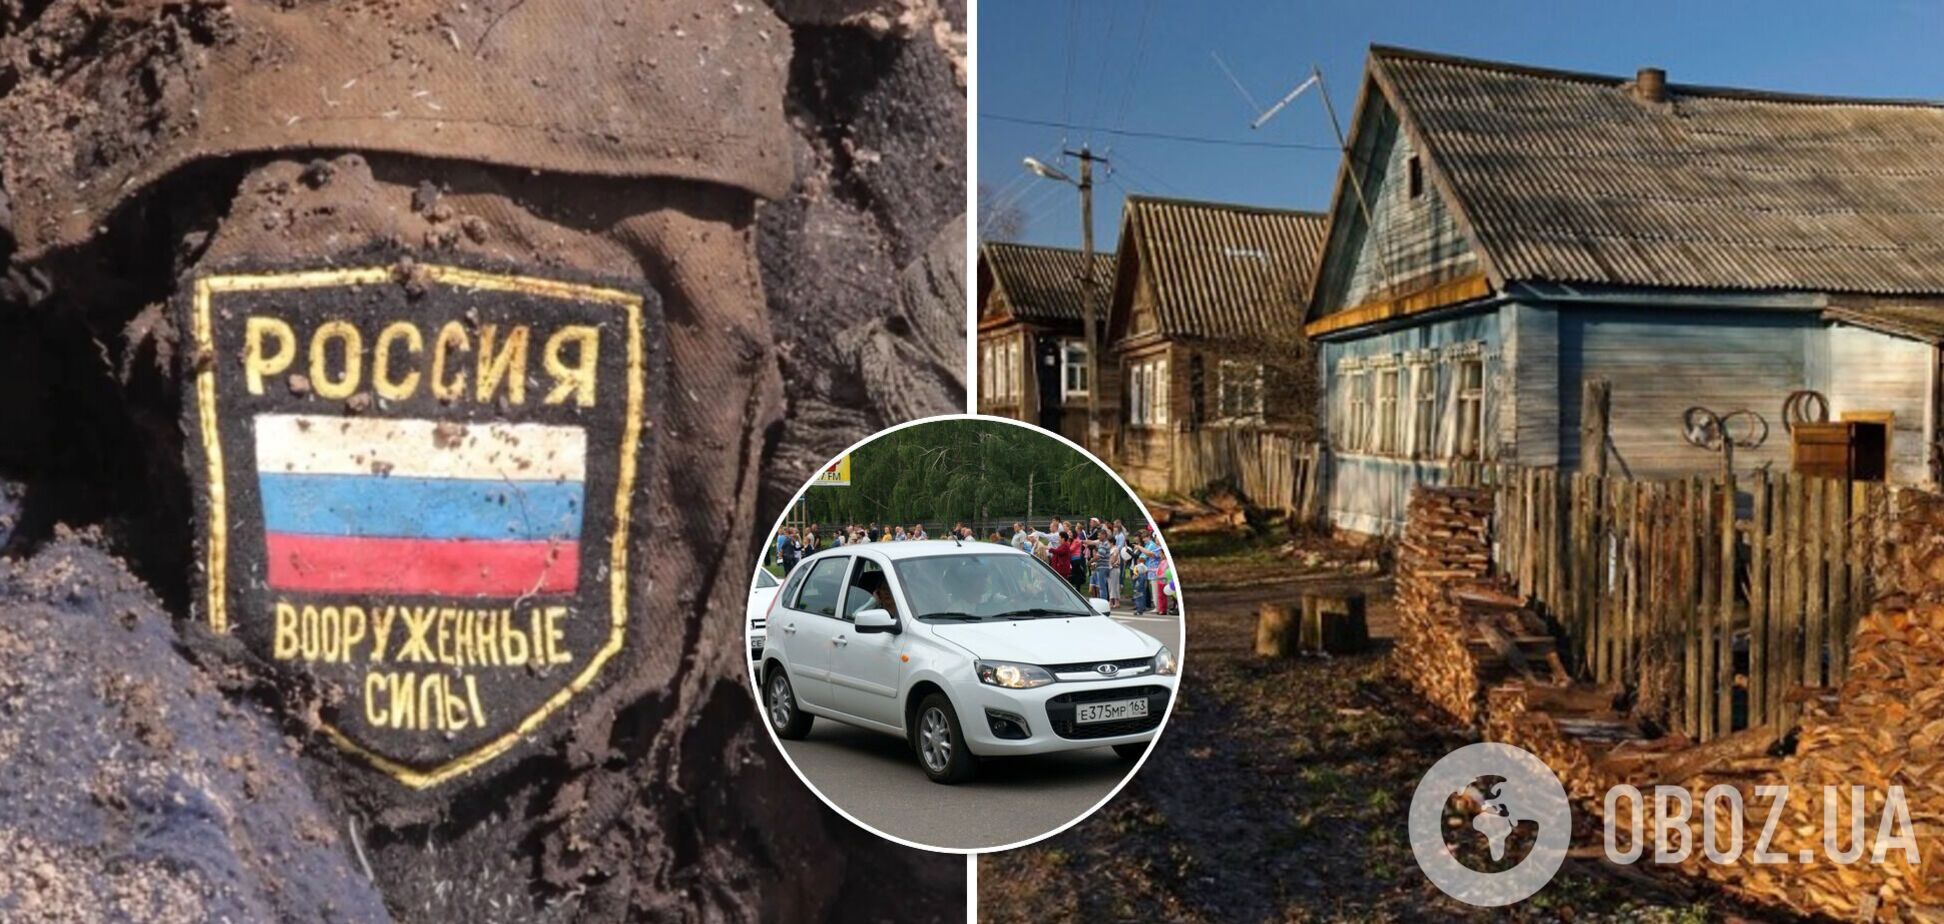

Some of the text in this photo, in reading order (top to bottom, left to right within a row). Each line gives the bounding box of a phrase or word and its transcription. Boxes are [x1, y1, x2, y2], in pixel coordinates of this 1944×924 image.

[245, 316, 599, 408] РОССИЯ
[273, 602, 574, 667] ВООРУЖЕННЫЕ
[364, 671, 486, 731] СИЛЫ
